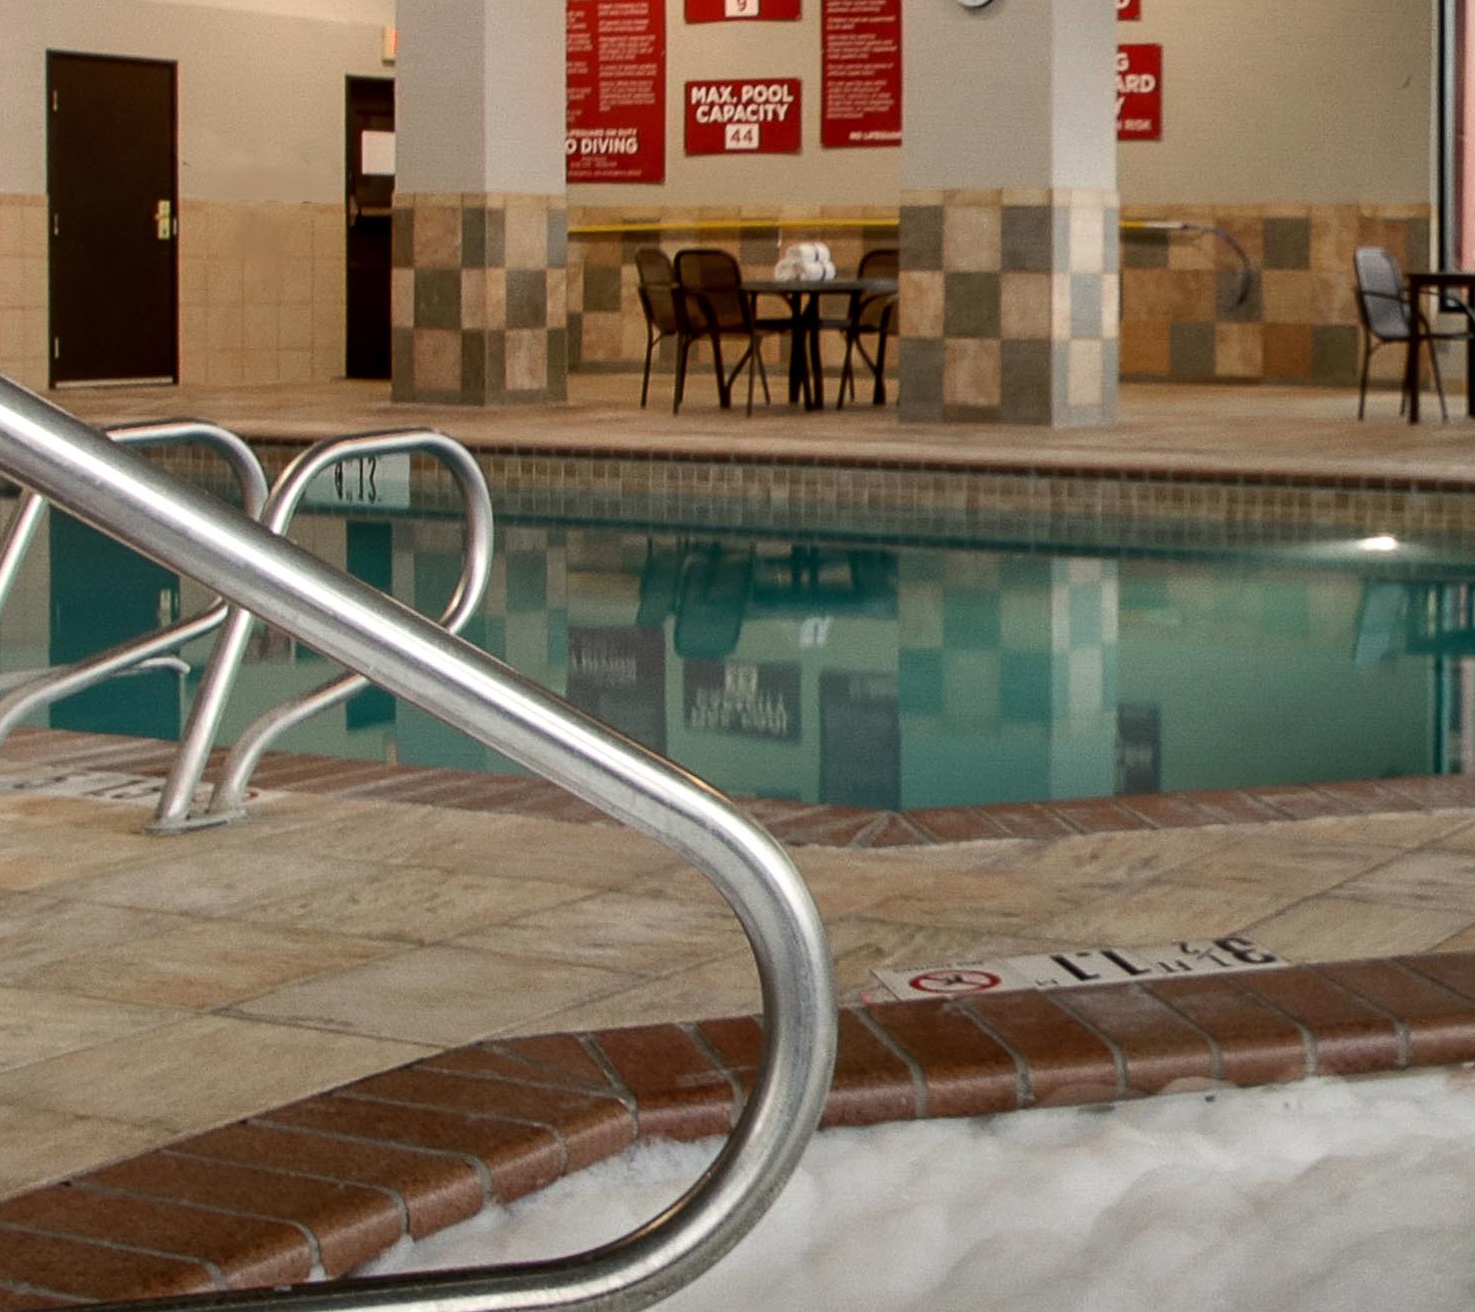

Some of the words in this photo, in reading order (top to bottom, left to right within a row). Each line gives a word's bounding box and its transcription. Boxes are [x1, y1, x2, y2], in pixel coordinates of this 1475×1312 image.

[691, 85, 737, 104] MAX.
[741, 84, 794, 103] POOL
[696, 103, 789, 123] CAPACITY
[730, 128, 753, 144] 44
[565, 138, 577, 154] O
[581, 138, 638, 154] DIVING
